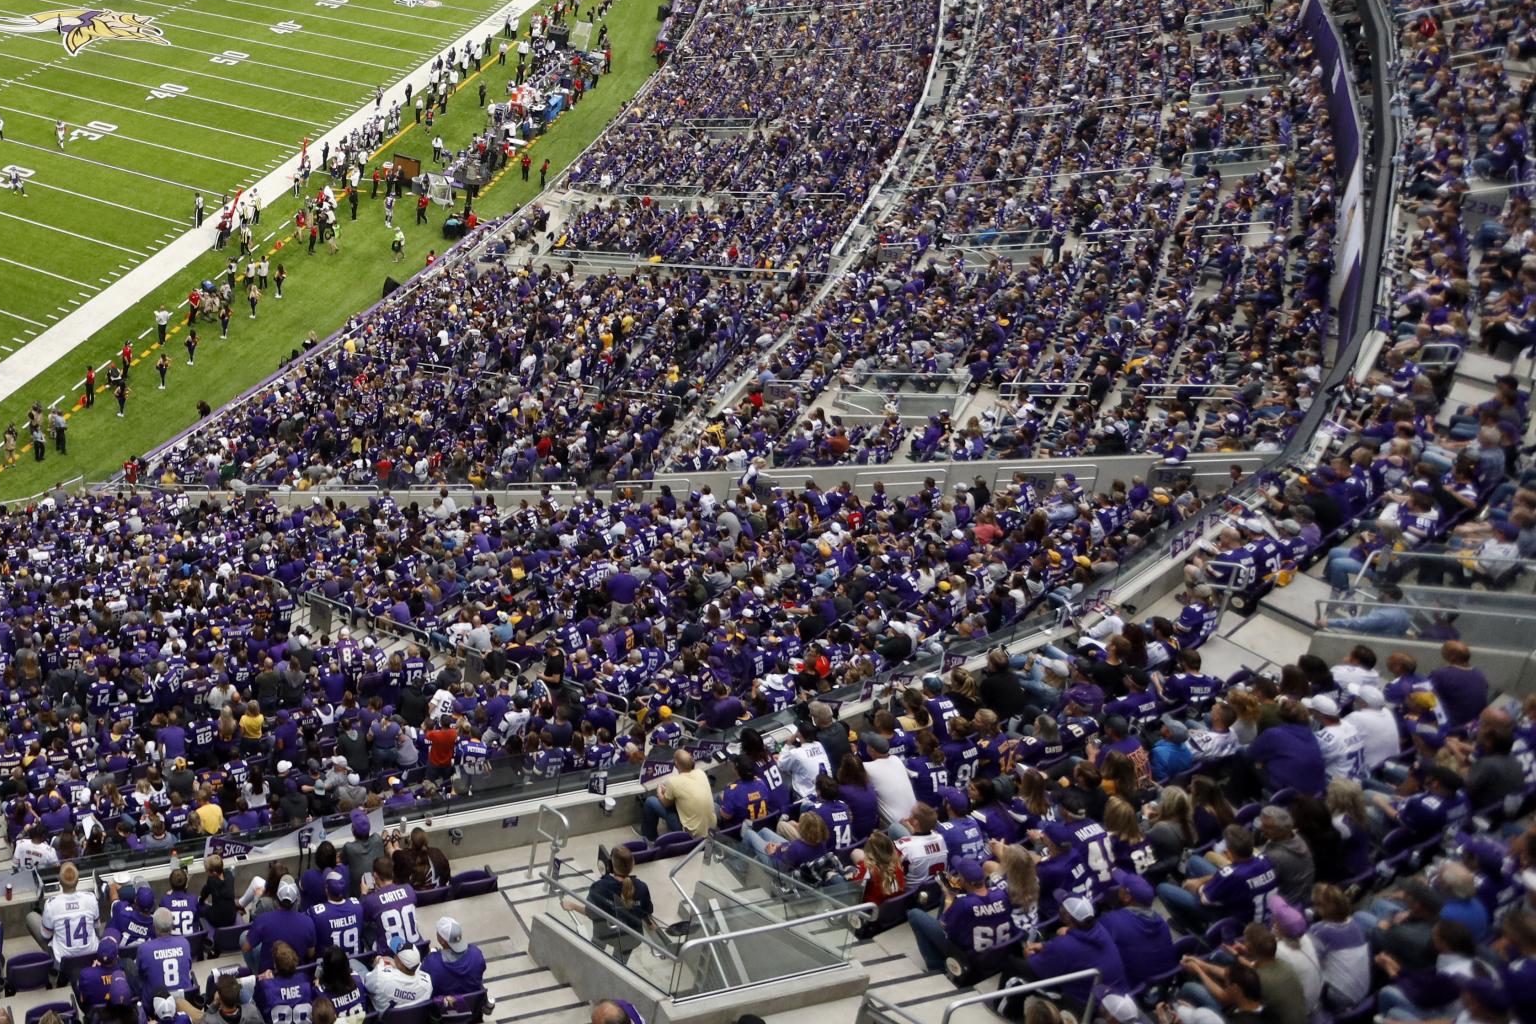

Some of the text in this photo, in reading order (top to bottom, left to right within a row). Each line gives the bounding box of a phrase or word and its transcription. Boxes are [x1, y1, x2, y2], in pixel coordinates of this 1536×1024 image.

[209, 50, 250, 66] 50
[70, 120, 119, 142] 30
[653, 763, 672, 777] SKOL
[763, 764, 783, 791] 19
[746, 800, 768, 821] 14
[833, 824, 852, 850] 14
[224, 842, 246, 856] SKOL
[924, 842, 941, 855] RYAN
[171, 898, 188, 908] SMITH
[379, 887, 408, 905] CARTER
[973, 899, 1006, 918] SAVAGE
[128, 921, 150, 937] DIGGS
[329, 914, 357, 929] THIELEN
[380, 904, 421, 944] 80
[63, 916, 89, 948] 14
[972, 921, 1012, 953] 66
[330, 928, 360, 956] 19
[153, 946, 184, 959] COUSINS
[162, 958, 181, 987] 8
[280, 985, 302, 1001] PAGE
[331, 986, 361, 1007] THIELEN
[394, 988, 417, 1001] DIGGS
